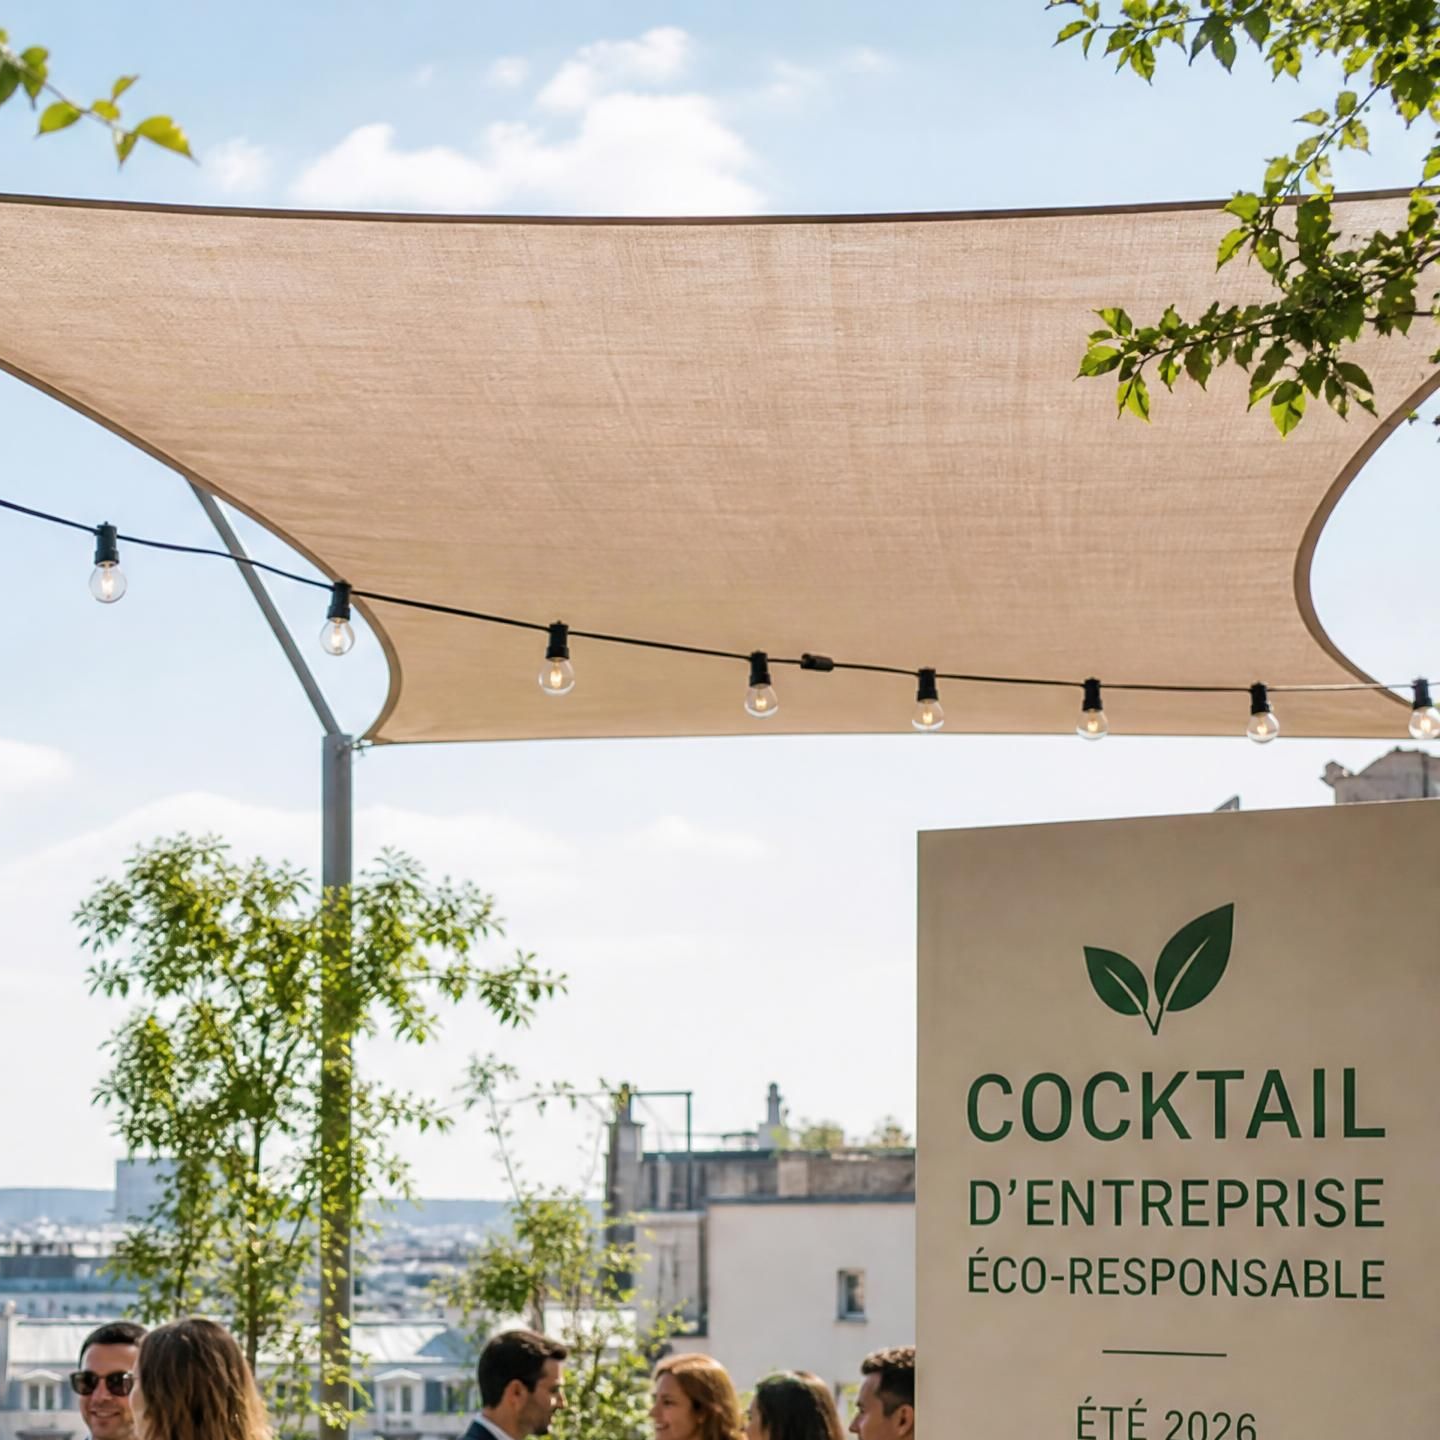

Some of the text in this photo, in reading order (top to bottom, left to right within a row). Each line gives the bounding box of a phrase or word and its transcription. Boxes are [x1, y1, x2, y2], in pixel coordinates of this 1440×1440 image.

[967, 1067, 1386, 1143] COCKTAIL
[969, 1178, 1385, 1229] D'ENTREPRISE
[968, 1246, 1385, 1300] ÉCO-RESPONSABLE
